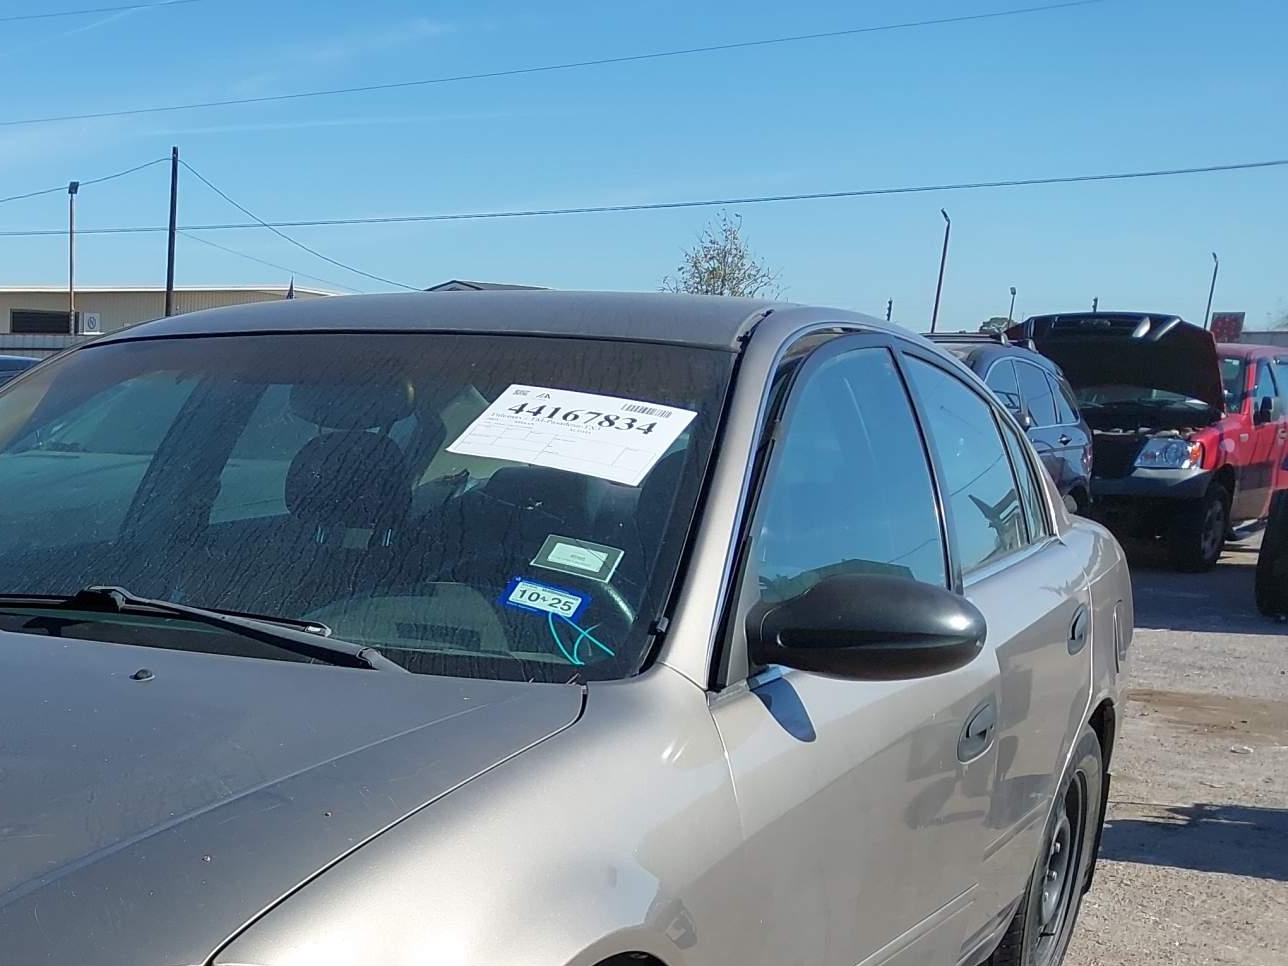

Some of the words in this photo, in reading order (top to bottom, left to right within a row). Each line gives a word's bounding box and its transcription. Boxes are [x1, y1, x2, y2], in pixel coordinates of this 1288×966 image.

[508, 401, 657, 435] 44167834
[518, 588, 541, 603] 10
[550, 597, 575, 613] 25
